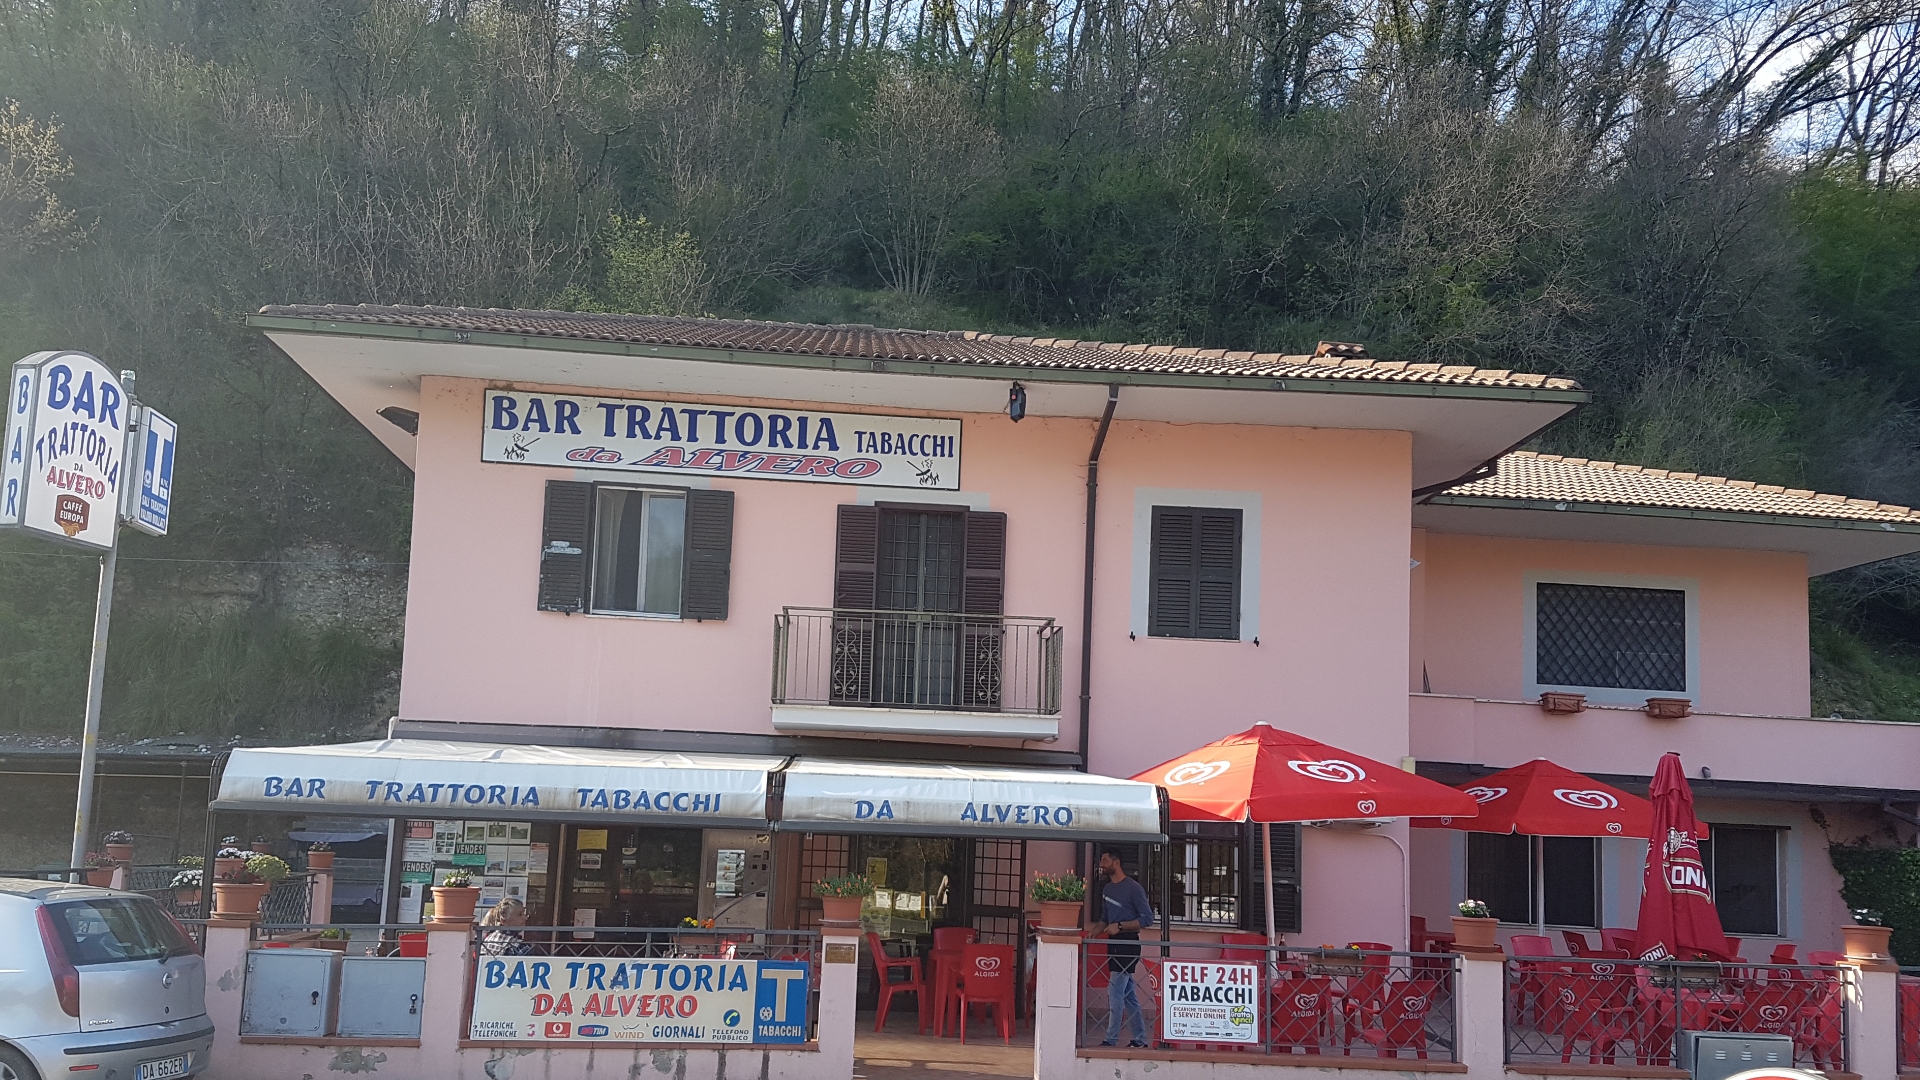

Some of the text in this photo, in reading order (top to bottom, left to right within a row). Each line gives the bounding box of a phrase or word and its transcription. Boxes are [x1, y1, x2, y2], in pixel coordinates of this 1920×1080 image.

[47, 364, 120, 431] BAR
[491, 395, 955, 459] BAR TRATTORIA TABACCHI
[5, 374, 30, 517] BAR
[151, 414, 173, 496] T
[35, 421, 119, 493] TRATTORIA
[73, 462, 84, 472] DA
[566, 445, 883, 480] da ALVERO
[46, 465, 105, 500] ALVERO
[59, 511, 84, 525] EUROPA
[263, 777, 722, 814] BAR TRATTORIA TABACCHI
[854, 800, 1074, 827] DA ALVERO
[455, 844, 485, 855] VENDESI
[402, 862, 432, 873] VENDESI
[484, 960, 749, 993] BAR TRATTORIA
[1169, 965, 1253, 986] SELF 24H
[761, 968, 804, 1023] T
[1169, 985, 1253, 1004] TABACCHI
[530, 992, 699, 1020] DA ALVERO
[89, 1018, 115, 1026] Punto
[479, 1021, 515, 1030] RICARICHE
[592, 1027, 607, 1035] TIM
[652, 1025, 706, 1039] GIORNALI
[712, 1028, 749, 1036] TELEFONO
[758, 1025, 801, 1037] TABACCHI
[1174, 1028, 1186, 1036] sky
[474, 1029, 518, 1038] TELEFONICHE
[614, 1031, 645, 1040] WIND
[143, 1057, 183, 1079] DA 662ER
